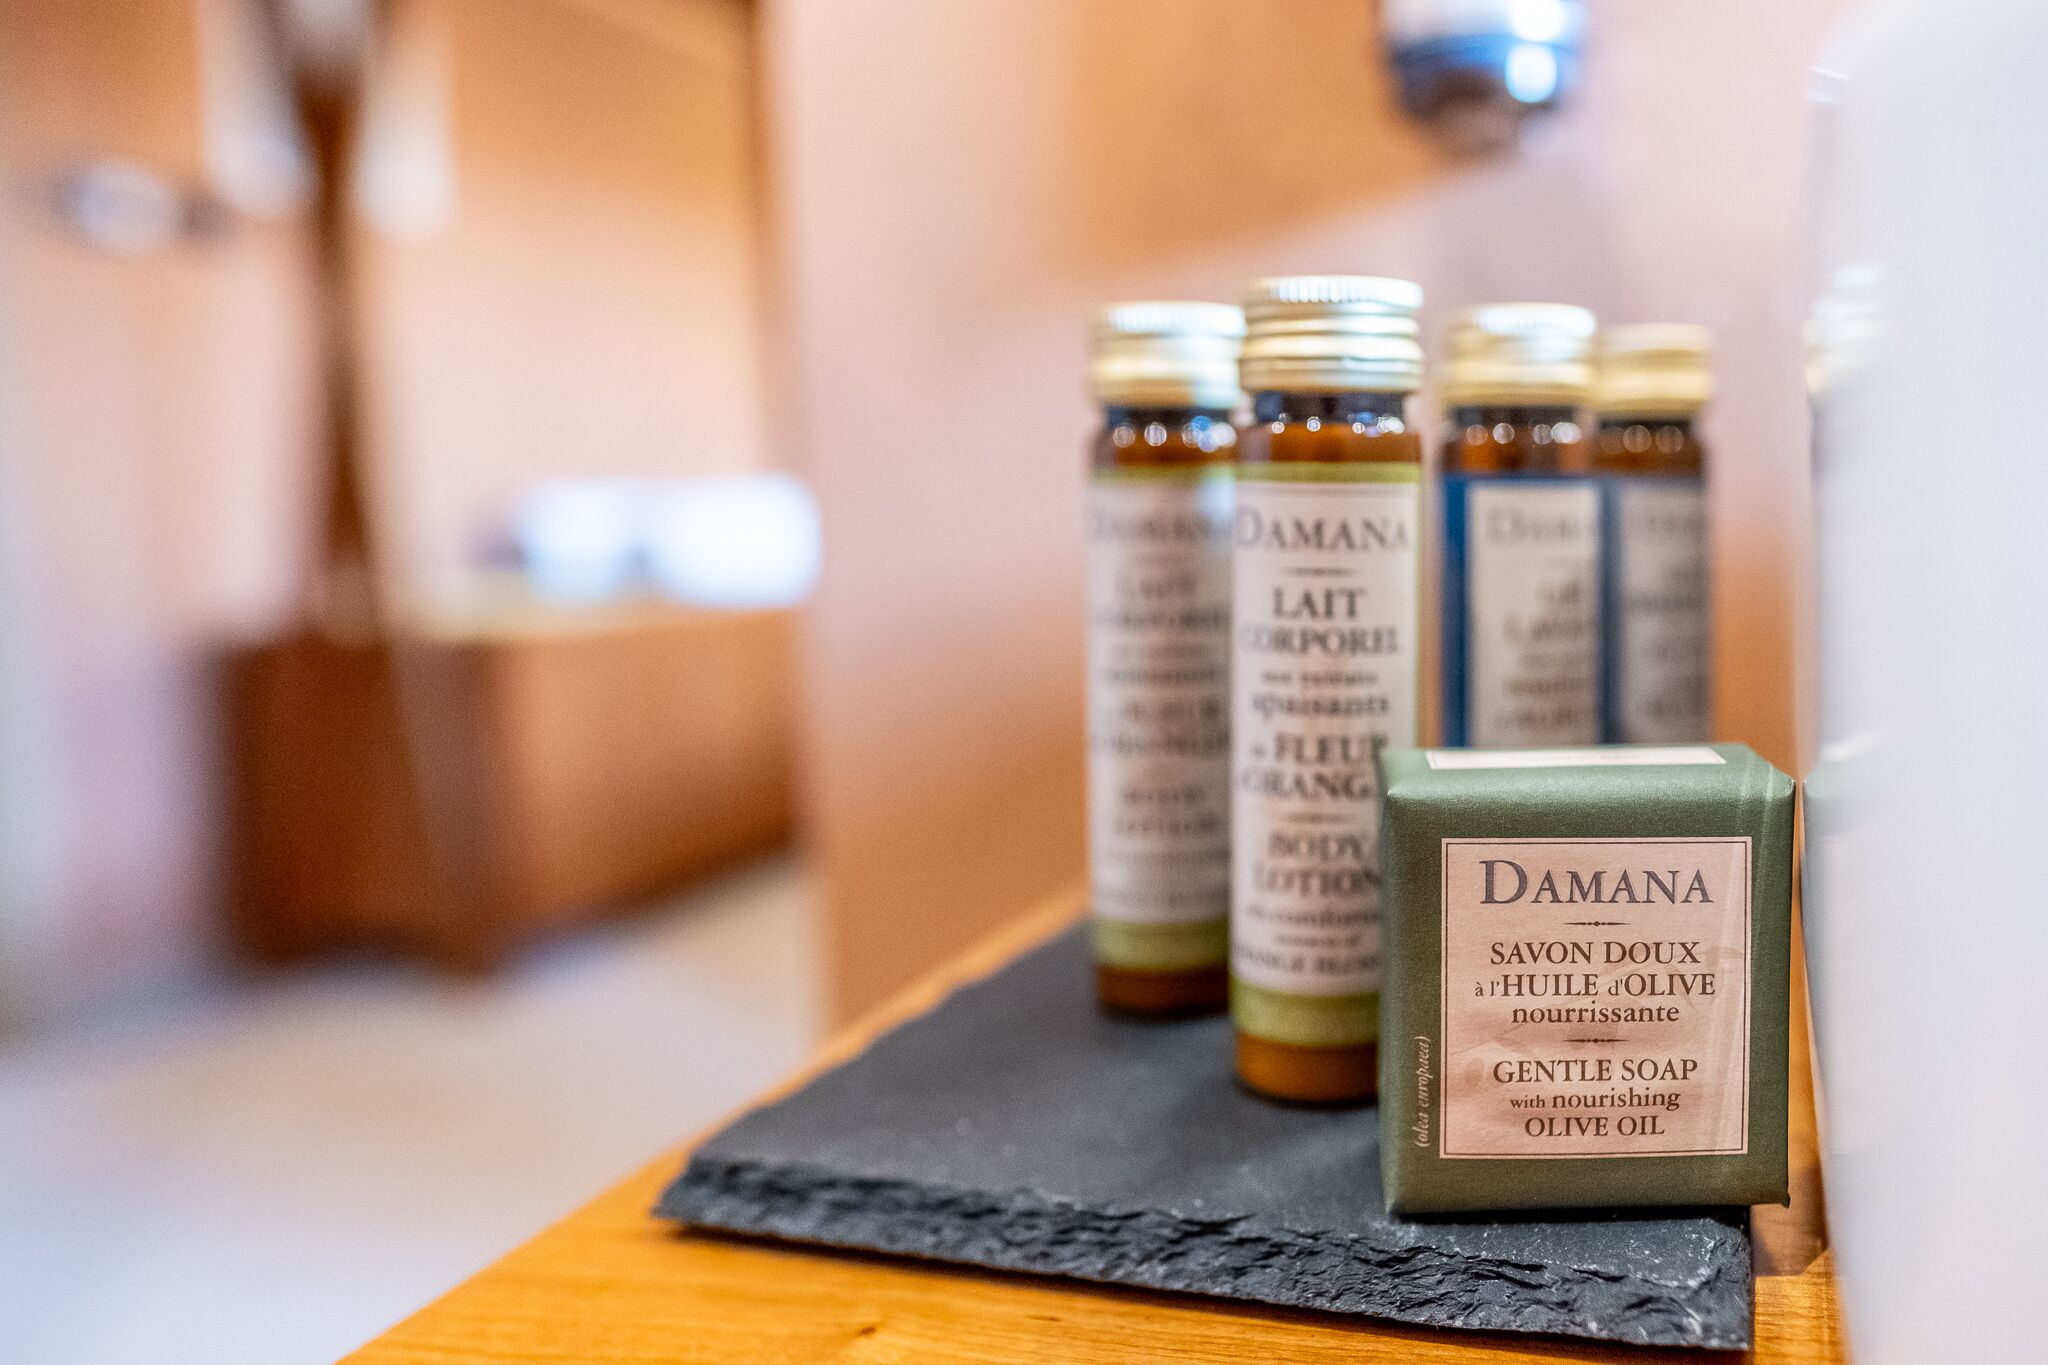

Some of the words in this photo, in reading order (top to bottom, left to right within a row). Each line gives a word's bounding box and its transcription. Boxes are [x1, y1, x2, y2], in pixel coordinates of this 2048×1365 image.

[1272, 586, 1367, 619] LAIT
[1479, 859, 1715, 905] DAMANA
[1490, 941, 1595, 966] SAVON
[1602, 940, 1702, 965] DOUX
[1474, 981, 1485, 997] à
[1607, 972, 1716, 997] d'OLIVE
[1511, 1000, 1680, 1025] nourrissante
[1492, 1059, 1613, 1085] GENTLE
[1620, 1058, 1699, 1083] SOAP
[1509, 1094, 1547, 1110] with
[1551, 1087, 1682, 1112] nourishing
[1523, 1115, 1609, 1138] OLIVE
[1616, 1115, 1666, 1137] OIL
